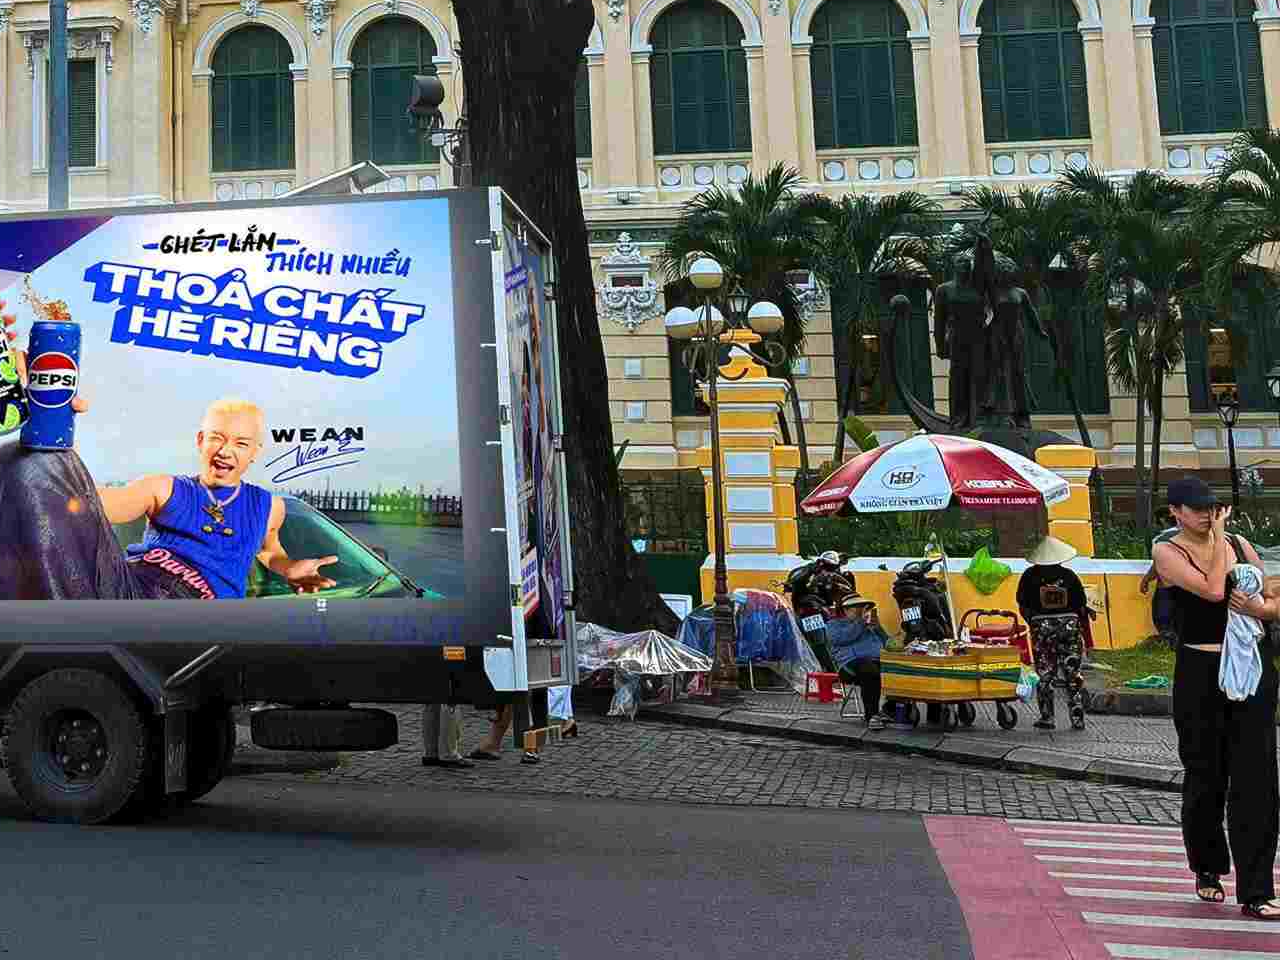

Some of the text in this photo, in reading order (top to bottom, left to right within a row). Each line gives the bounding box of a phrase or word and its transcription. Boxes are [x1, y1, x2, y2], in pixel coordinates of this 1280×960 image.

[265, 246, 413, 278] THÍCH NHIỀU
[100, 262, 426, 335] THOẢ CHẤT
[128, 303, 383, 370] HÈ RIÊNG
[30, 372, 77, 387] PEPSI
[271, 426, 364, 443] WEAN
